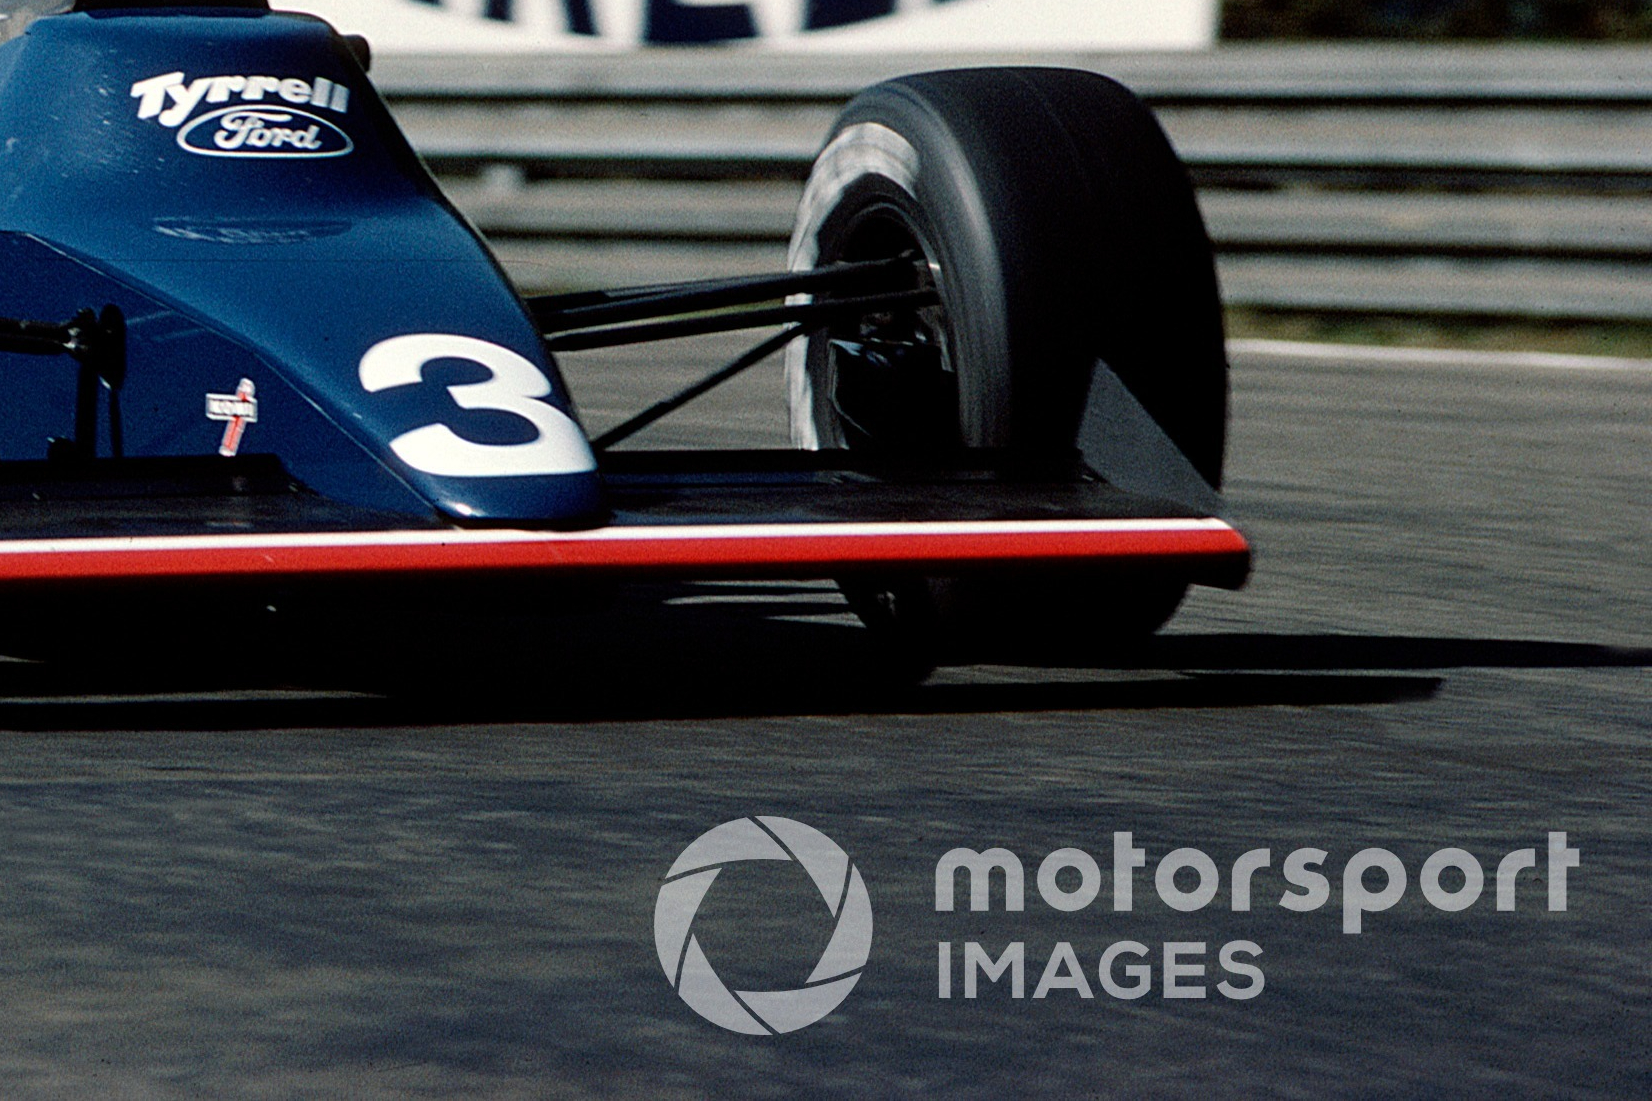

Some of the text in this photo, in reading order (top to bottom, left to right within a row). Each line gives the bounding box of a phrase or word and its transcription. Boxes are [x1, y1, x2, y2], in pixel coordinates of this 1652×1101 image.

[130, 71, 350, 128] Tyrrell
[213, 111, 323, 150] Ford
[358, 332, 598, 477] 3
